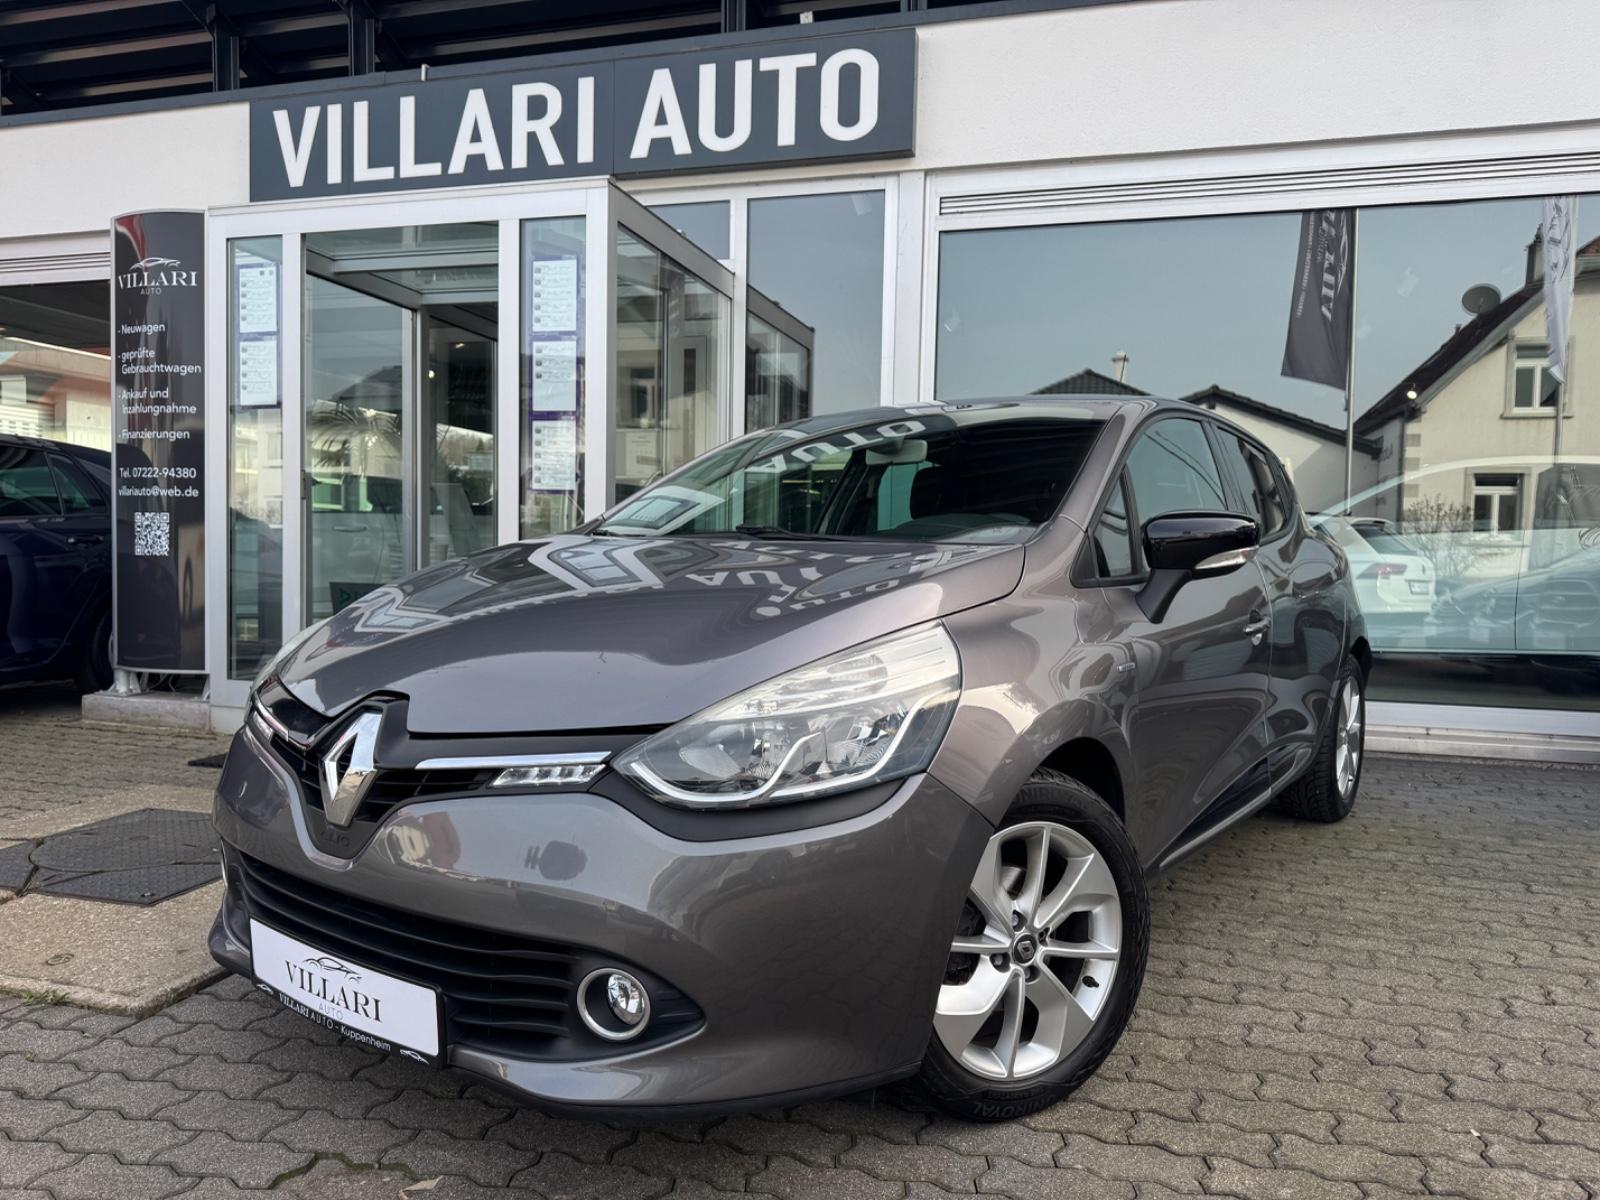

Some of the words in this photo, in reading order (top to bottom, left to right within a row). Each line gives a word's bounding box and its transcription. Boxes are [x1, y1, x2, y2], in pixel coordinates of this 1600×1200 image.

[272, 76, 596, 188] VILLARI
[630, 47, 881, 160] AUTO
[117, 271, 198, 289] VILLARI
[121, 363, 201, 376] Gebrauchtwagen
[150, 388, 169, 398] und
[119, 467, 132, 478] Tel.
[132, 467, 197, 479] 07222-94380
[118, 485, 199, 497] villariauto@web.de
[285, 960, 382, 1023] VILLARI
[318, 1001, 344, 1021] AUTO
[278, 993, 310, 1018] VILLARI
[309, 1012, 333, 1030] AUTO
[340, 1024, 391, 1051] Kuppenheim
